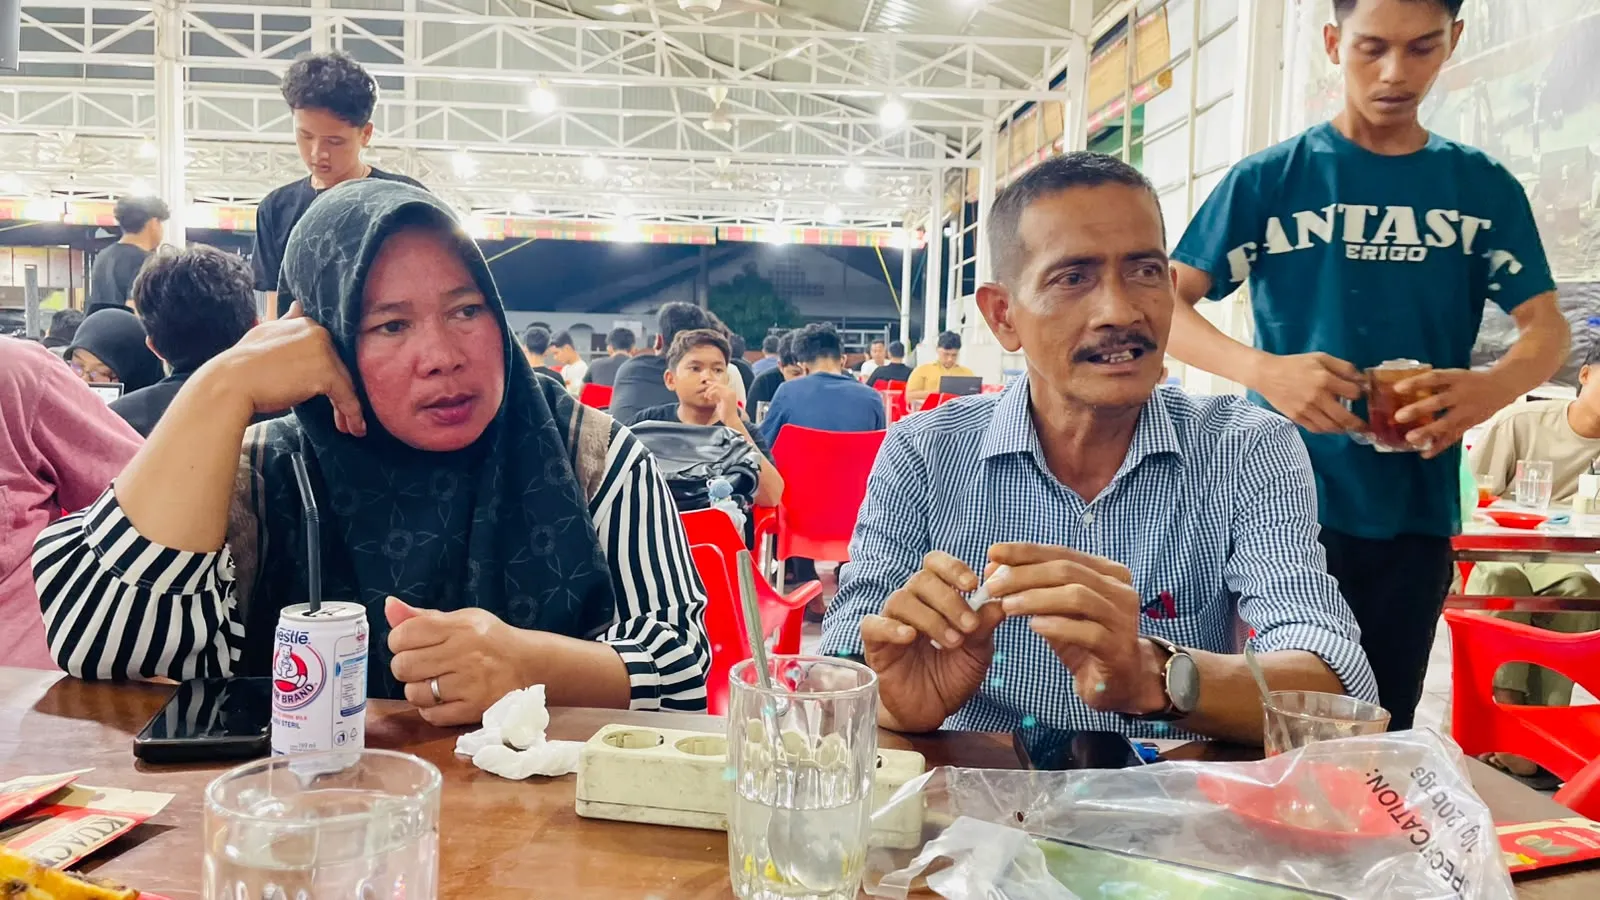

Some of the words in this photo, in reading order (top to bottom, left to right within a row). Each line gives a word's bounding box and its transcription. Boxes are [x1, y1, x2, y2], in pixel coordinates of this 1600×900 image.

[1227, 203, 1523, 291] FANTAST
[1345, 244, 1428, 262] ERIGO
[281, 684, 314, 703] BRAND
